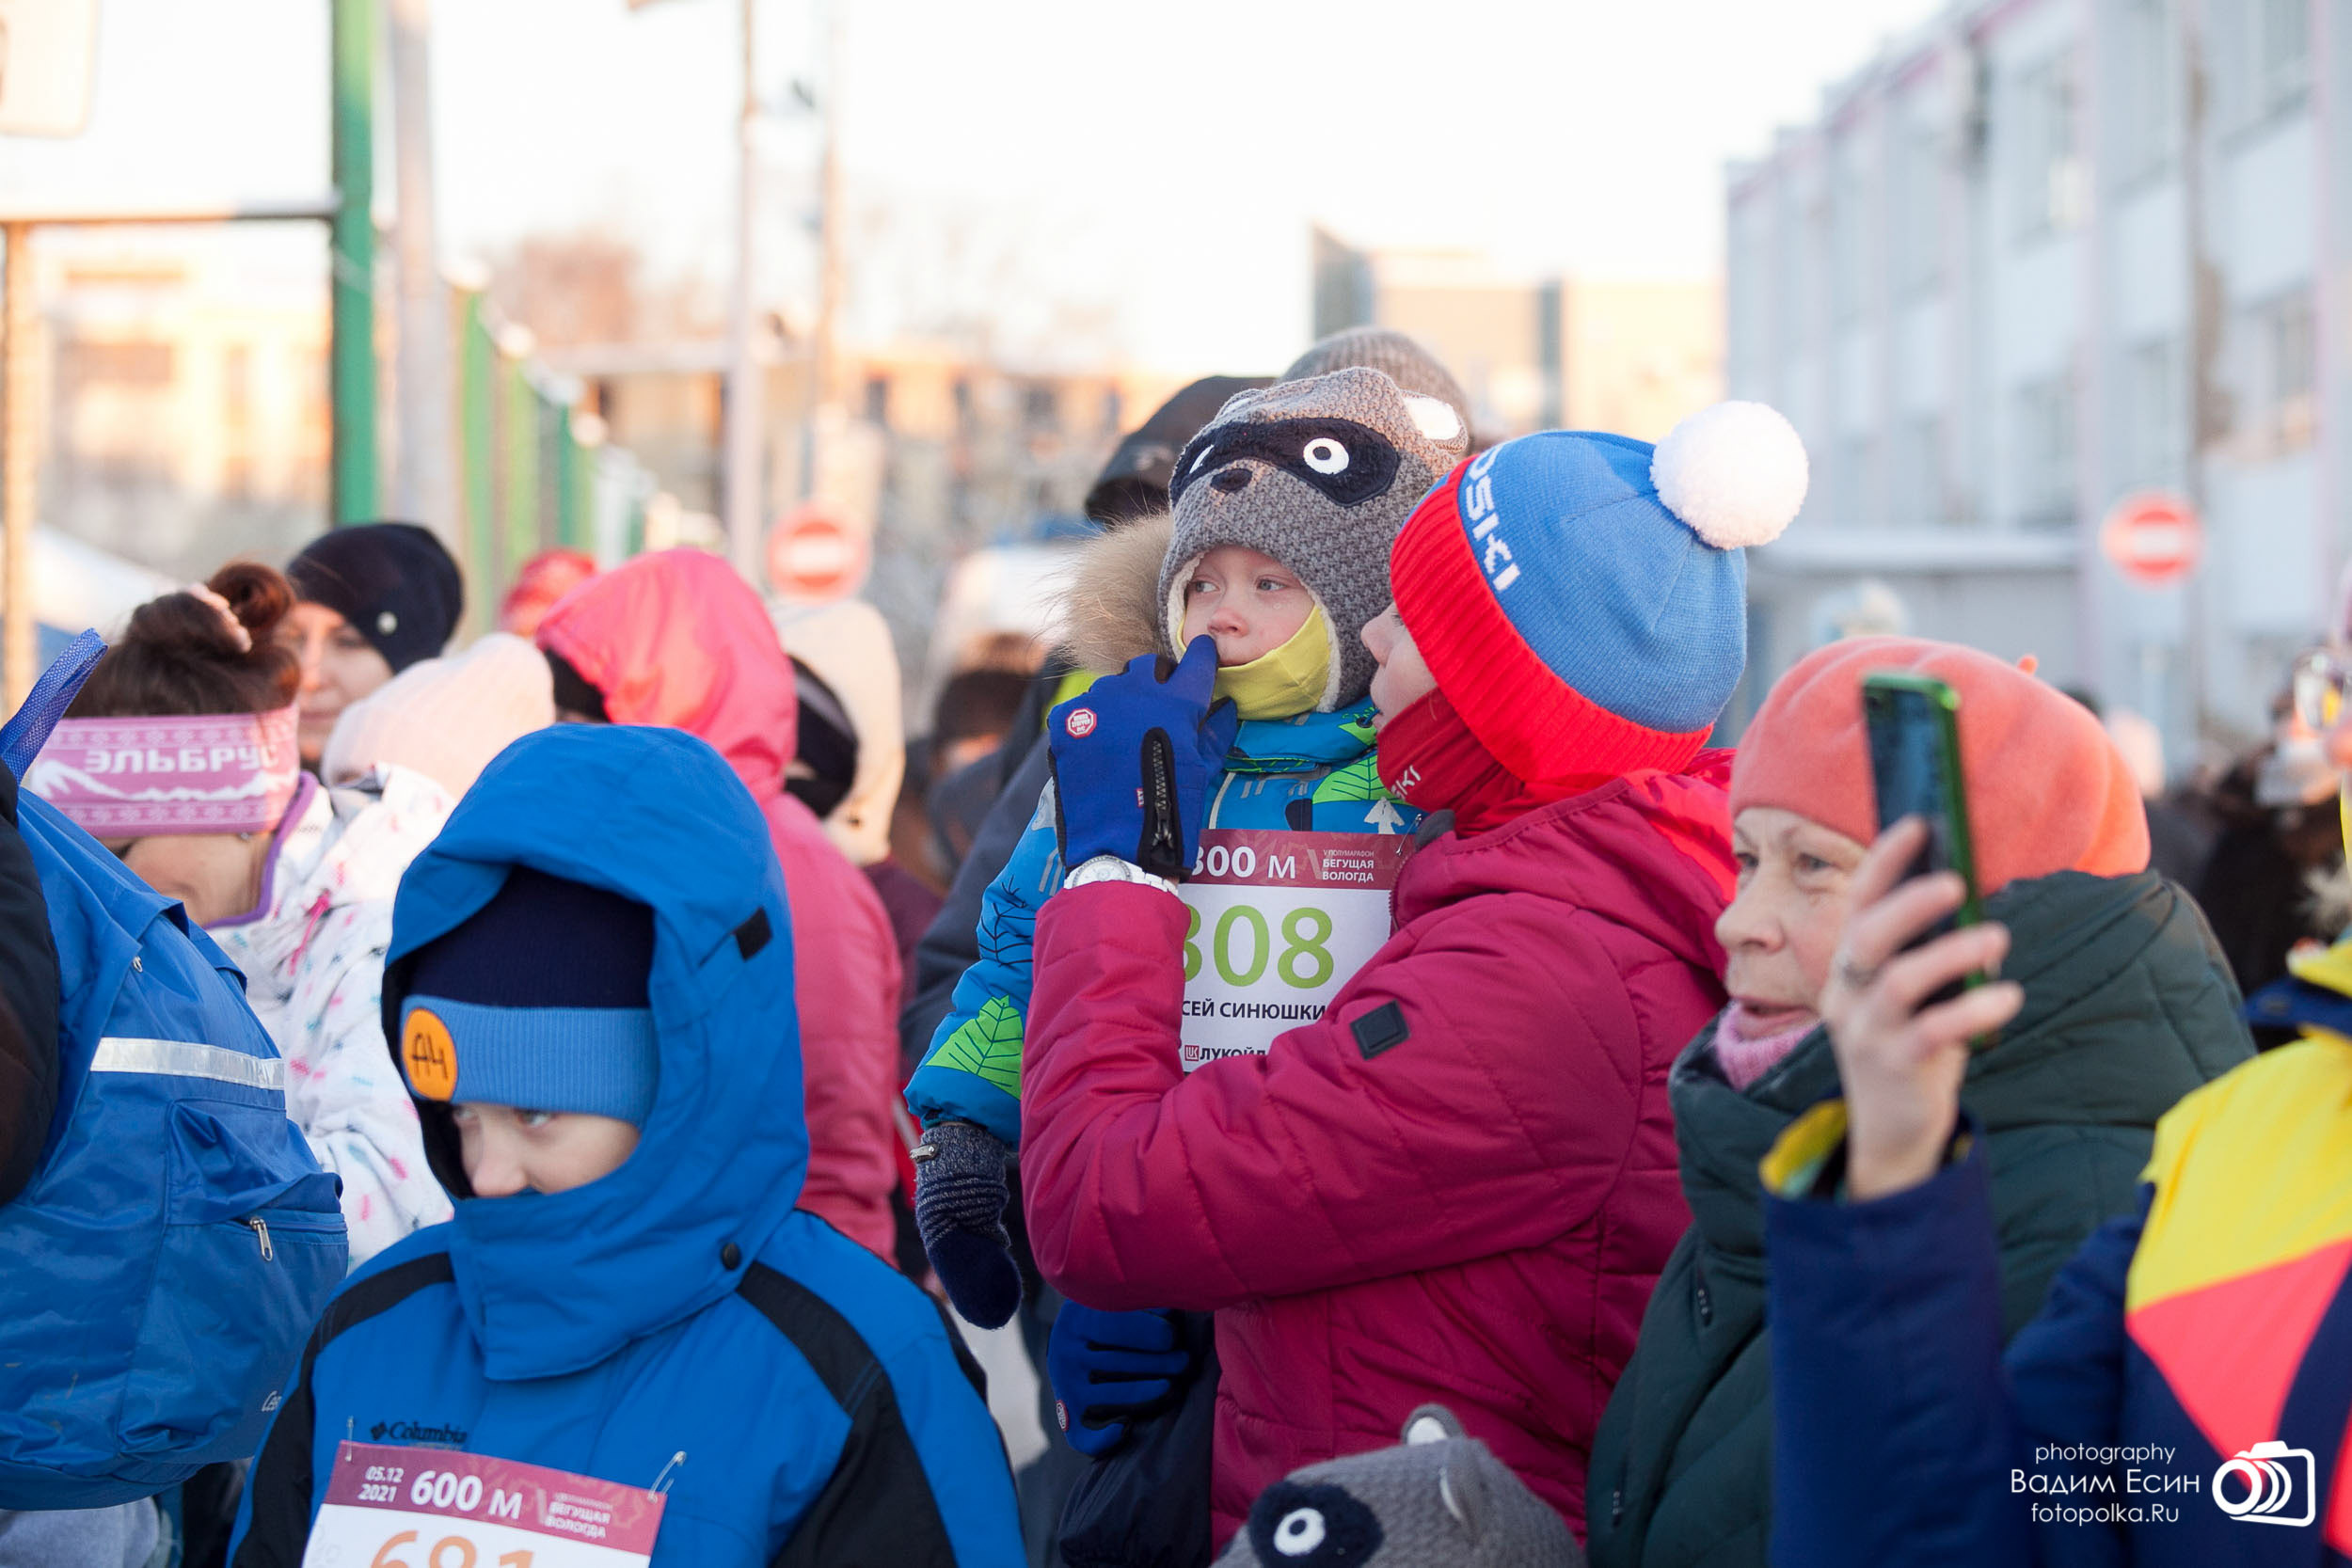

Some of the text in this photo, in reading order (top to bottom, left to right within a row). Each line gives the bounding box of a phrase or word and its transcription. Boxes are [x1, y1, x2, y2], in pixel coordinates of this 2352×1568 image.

[85, 745, 279, 775] ЭЛЬБРУС
[1267, 854, 1295, 879] М
[1322, 858, 1375, 870] БЕГУЩАЯ
[1322, 871, 1375, 883] ВОЛОГДА
[364, 1465, 405, 1483] 05.12
[358, 1483, 398, 1503] 2021
[410, 1469, 484, 1513] 600
[488, 1488, 524, 1520] М
